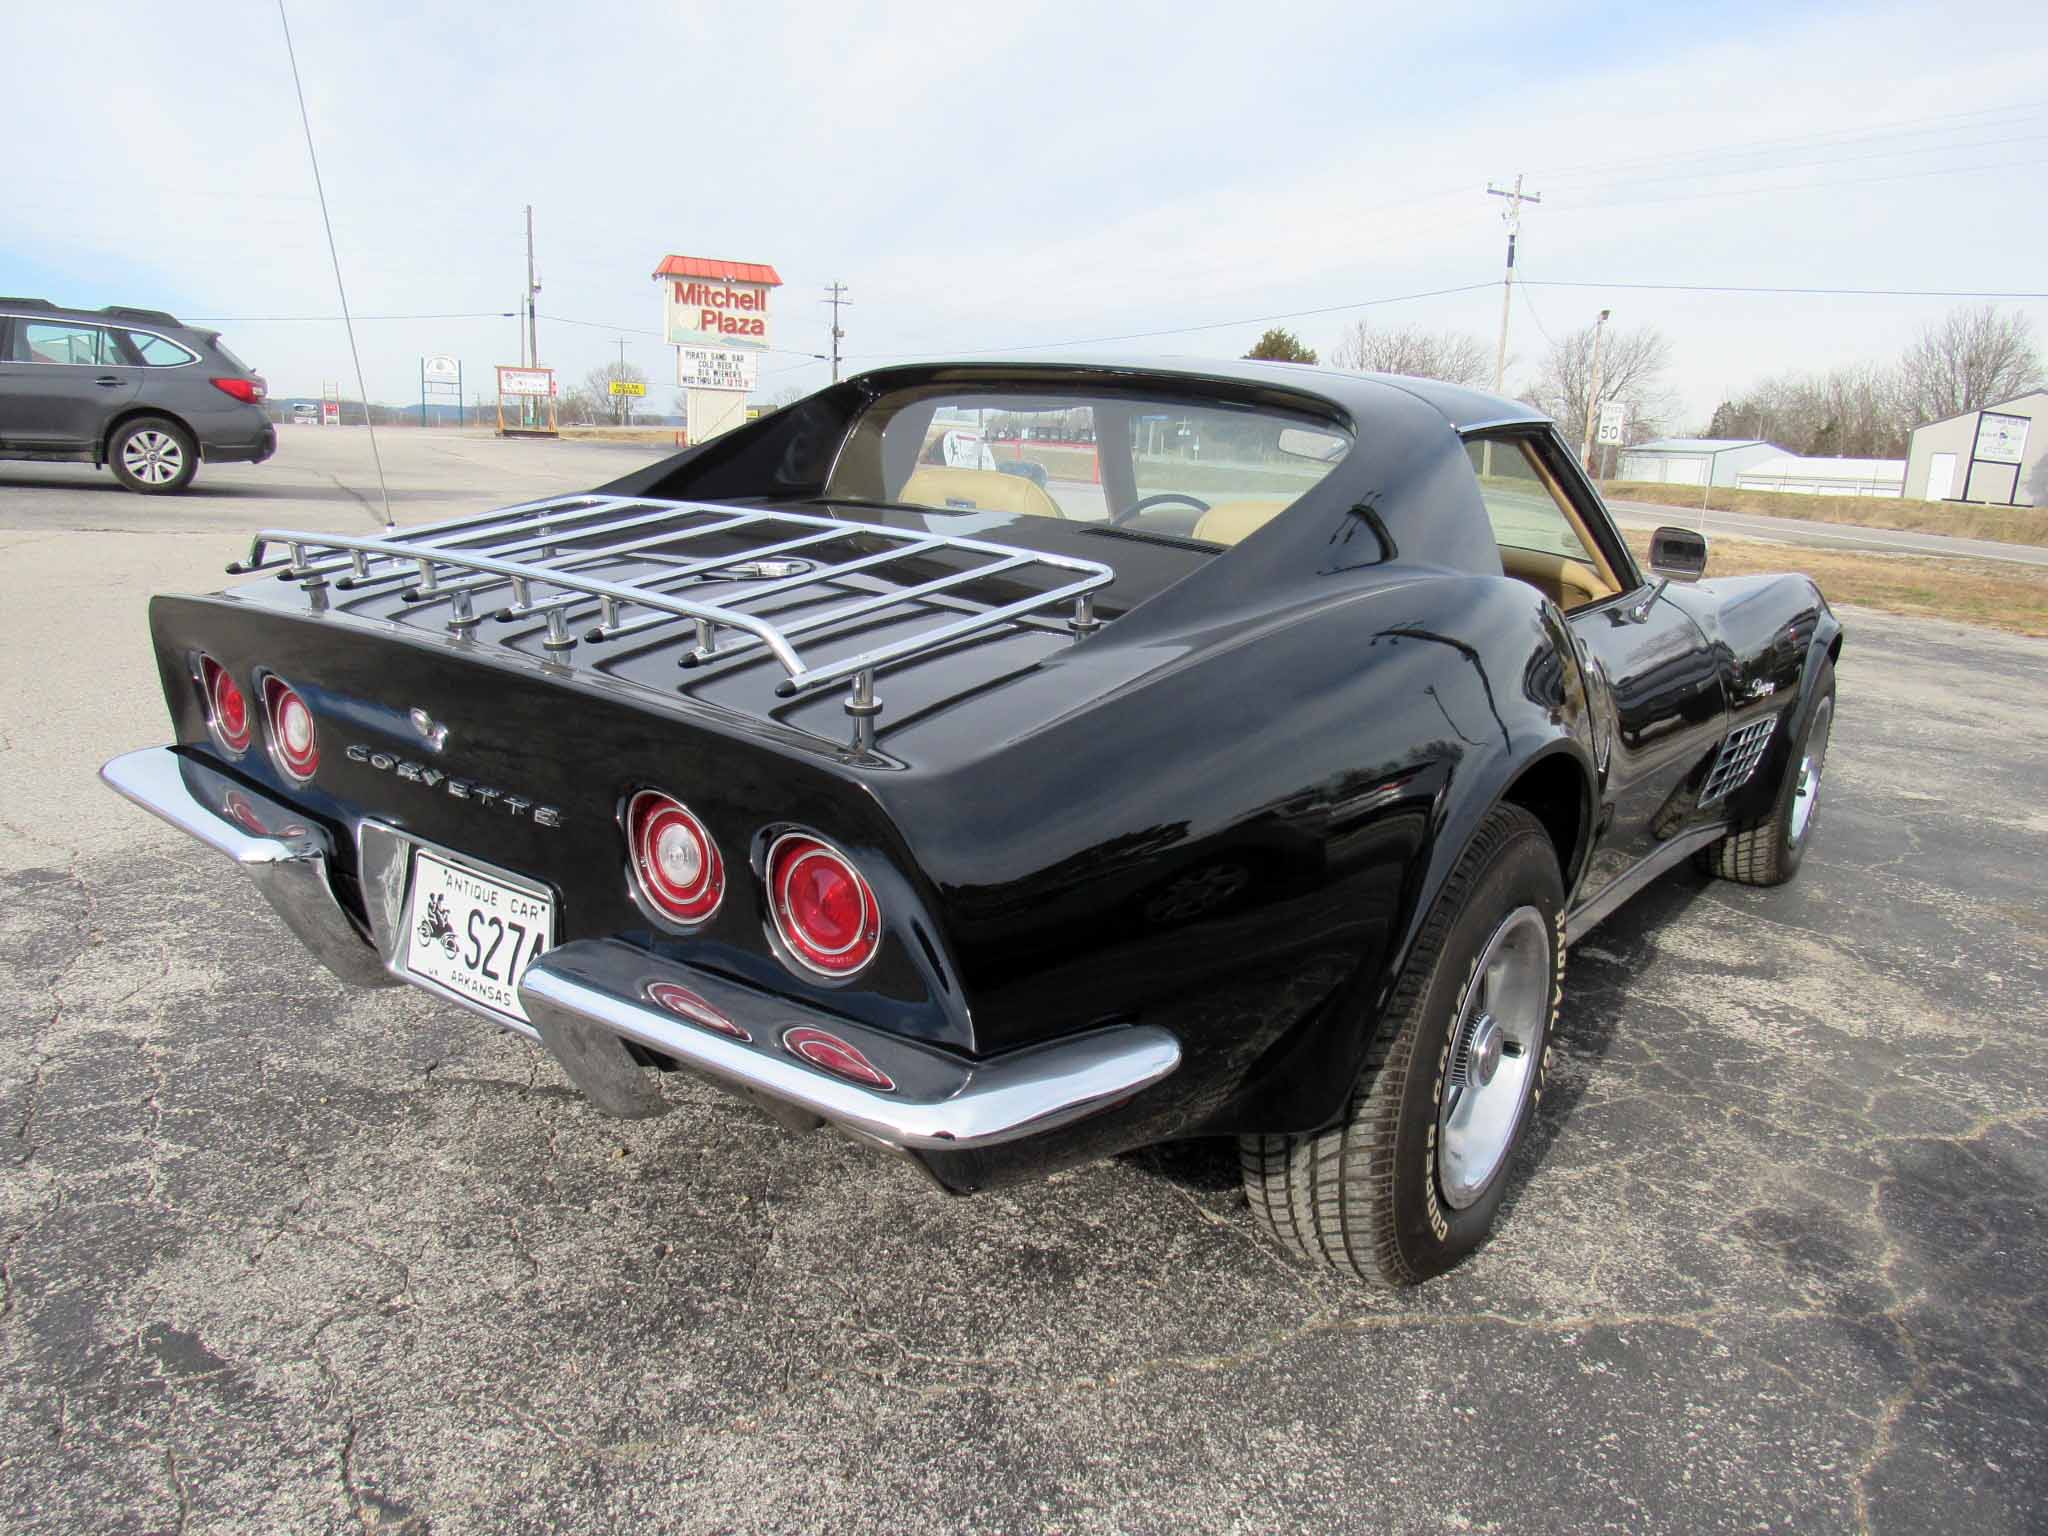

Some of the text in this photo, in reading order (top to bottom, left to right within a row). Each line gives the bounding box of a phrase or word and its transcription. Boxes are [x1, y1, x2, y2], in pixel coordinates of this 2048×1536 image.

[674, 281, 766, 311] Mitchell
[700, 309, 765, 336] Plaza
[696, 376, 712, 384] THRU
[698, 360, 714, 368] COLD
[1600, 425, 1618, 440] 50
[345, 744, 561, 828] CORVETTE
[446, 873, 540, 920] ANTIQUE CAR
[1549, 908, 1567, 1031] RADIAL
[451, 970, 511, 1007] ARKANSAS
[1426, 1123, 1448, 1241] COOPER
